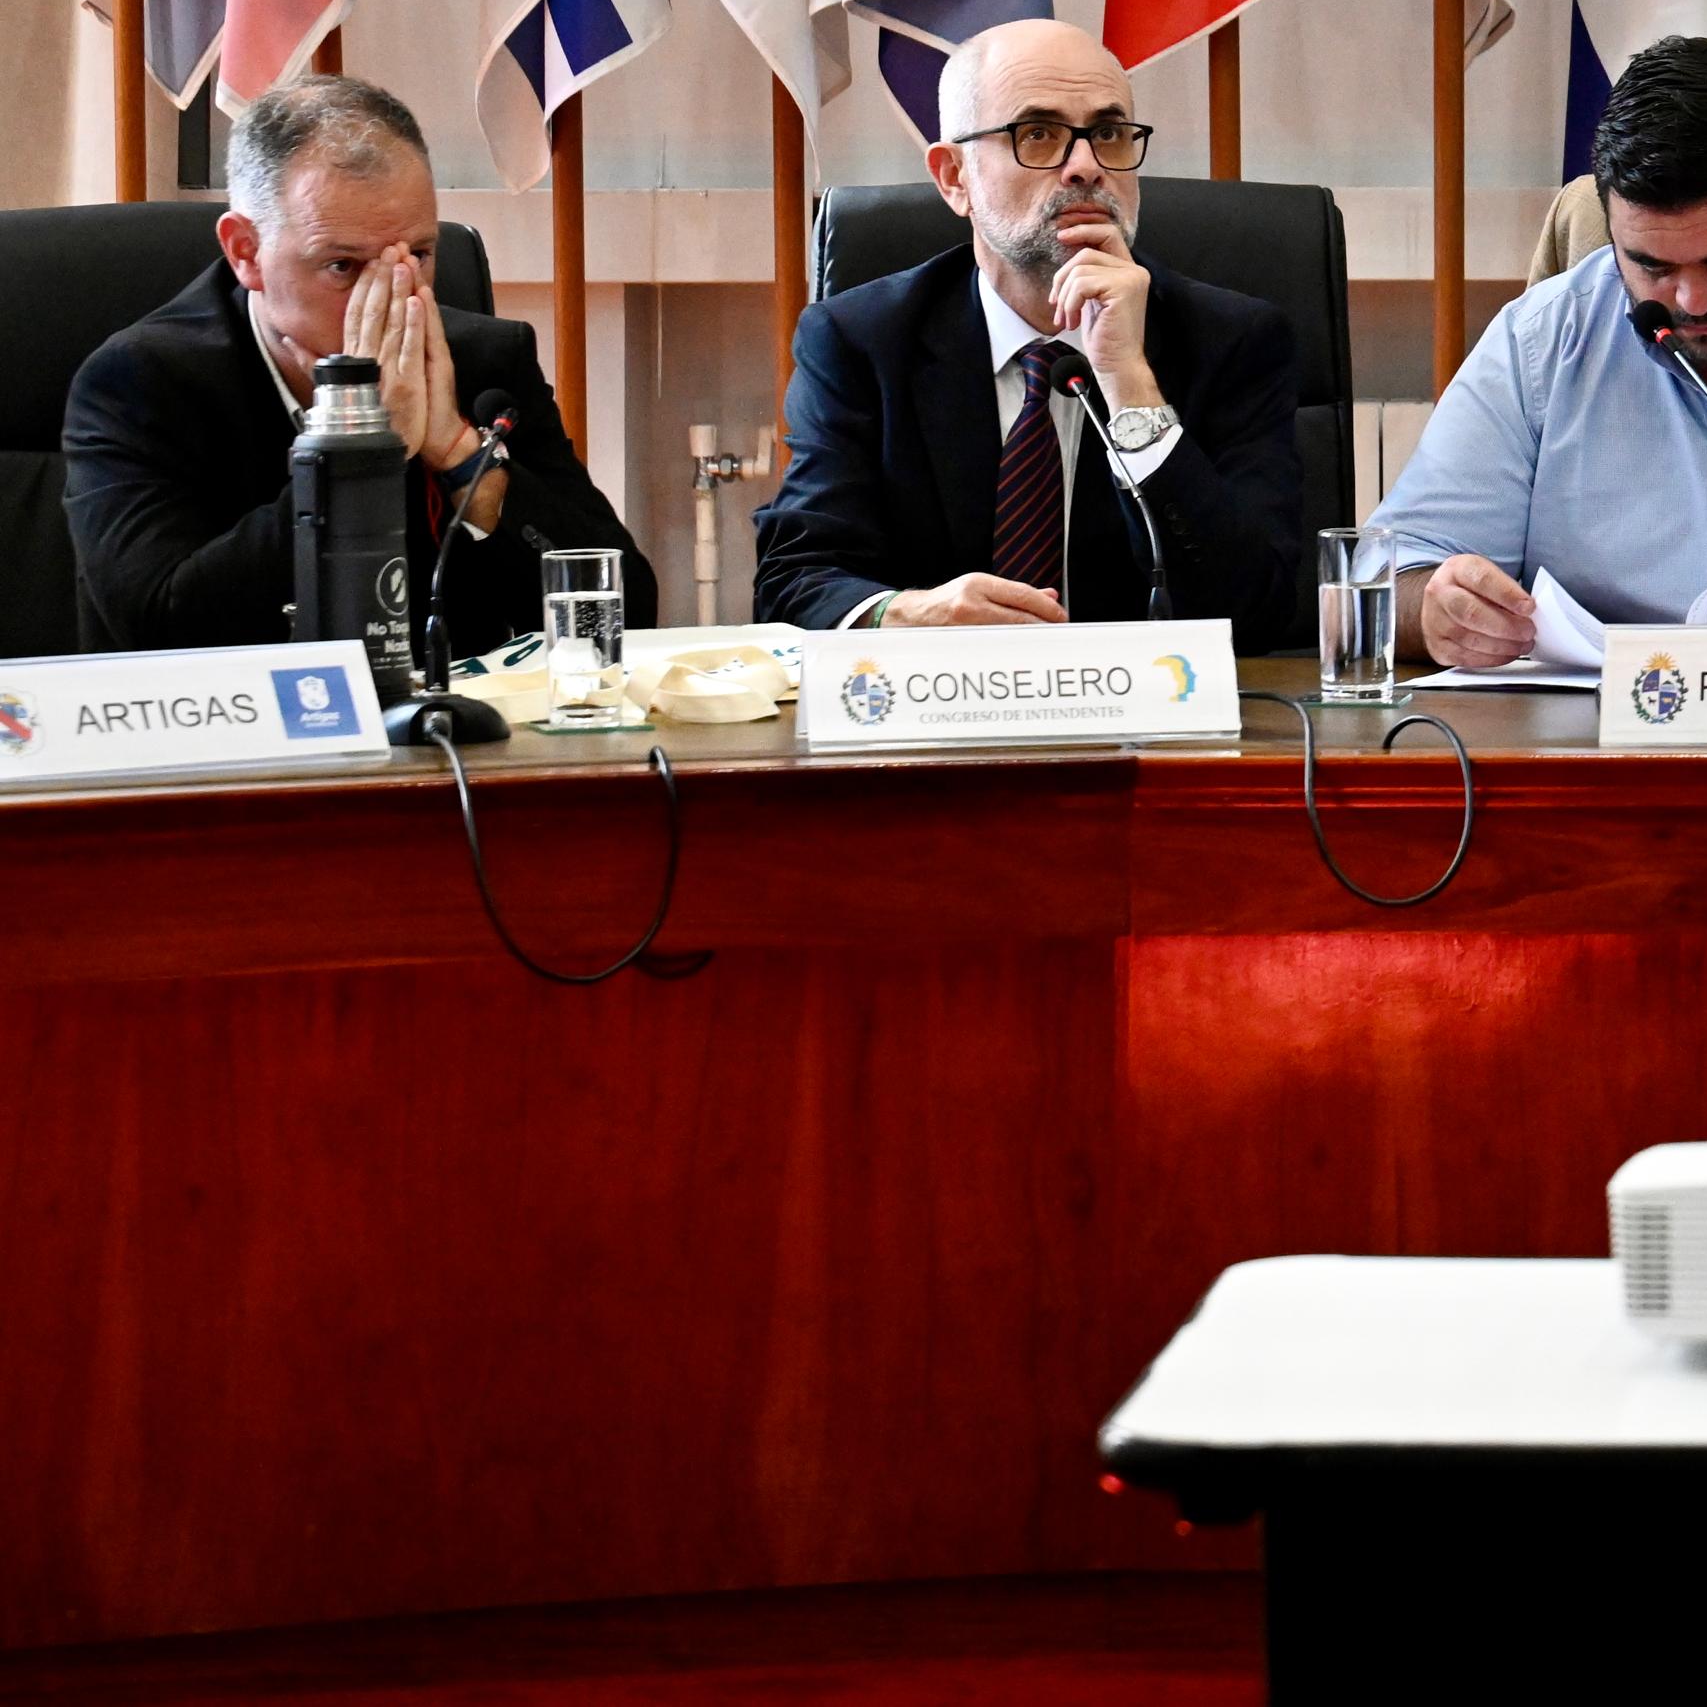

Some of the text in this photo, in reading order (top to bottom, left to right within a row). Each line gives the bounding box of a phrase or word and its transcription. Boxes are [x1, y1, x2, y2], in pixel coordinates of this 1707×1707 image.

[906, 666, 1132, 703] CONSEJERO
[77, 693, 258, 735] ARTIGAS
[919, 705, 1124, 724] CONGRESO DE INTENDENTES
